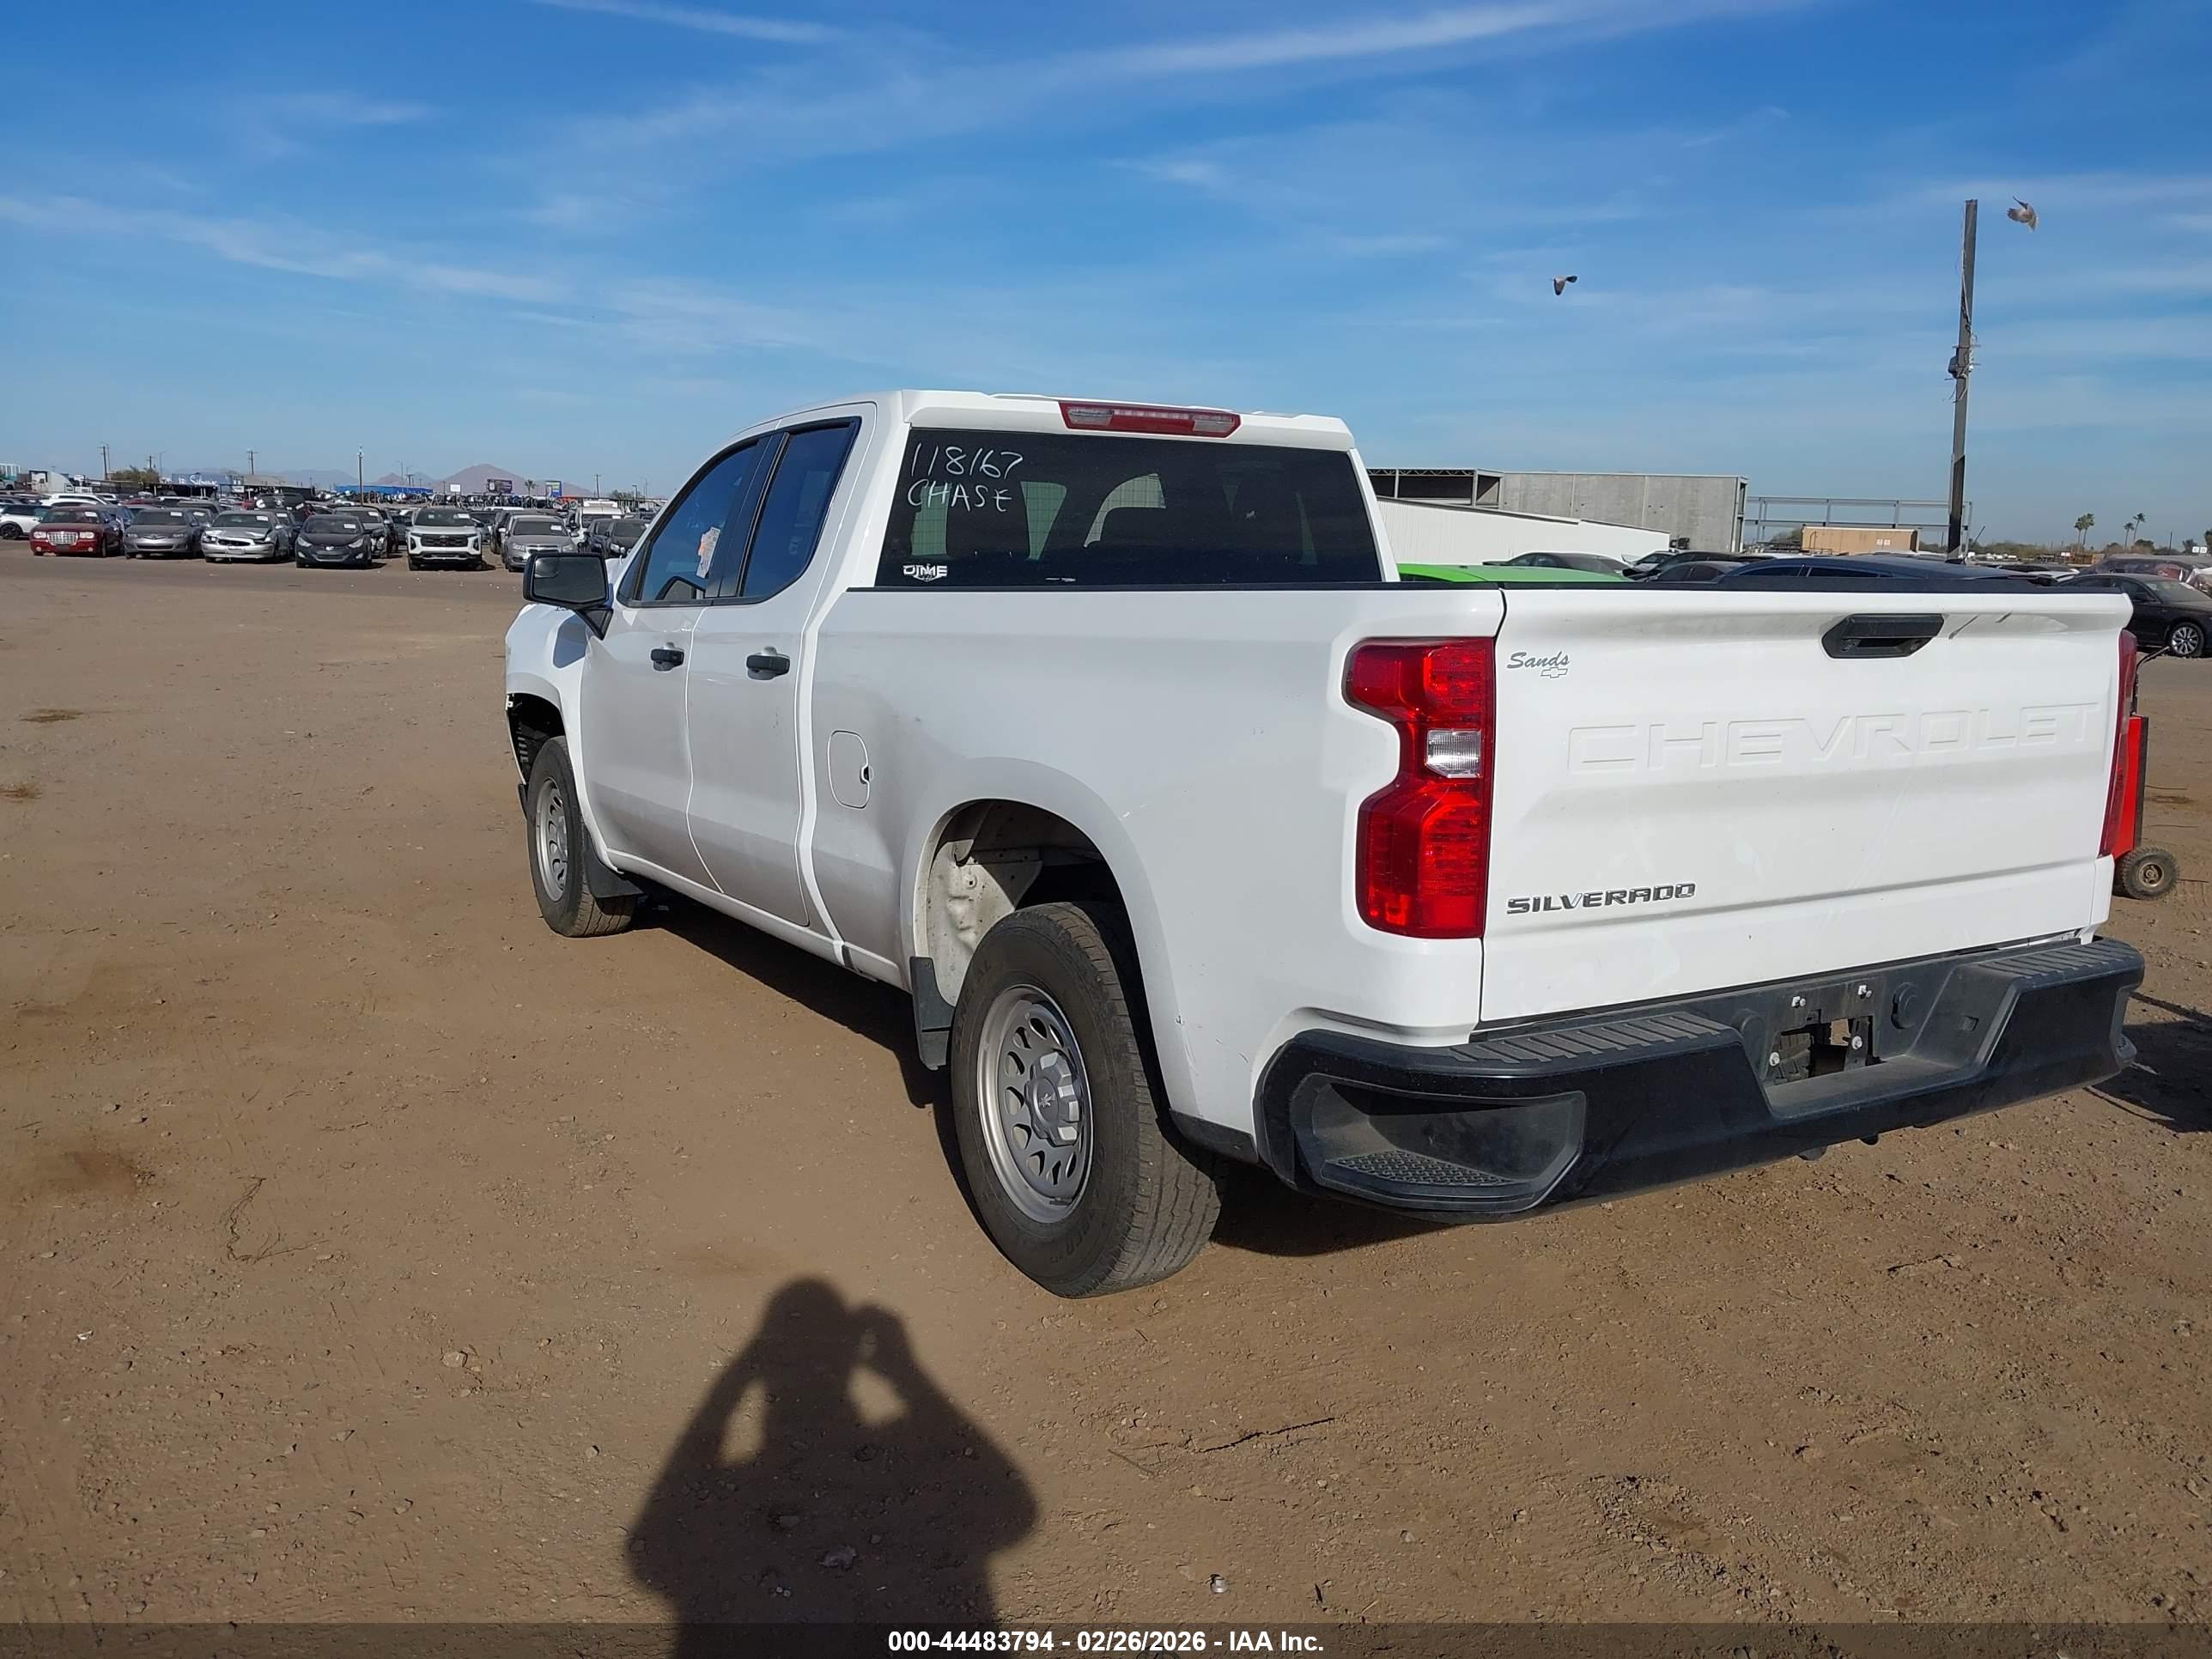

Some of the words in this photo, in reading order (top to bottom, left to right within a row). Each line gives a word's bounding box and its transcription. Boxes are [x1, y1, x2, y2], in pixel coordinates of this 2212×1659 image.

[911, 442, 1024, 479] 118167
[907, 478, 1012, 512] CHASE
[1506, 651, 1570, 669] Sands
[1567, 702, 2100, 775] CHEVROLET
[1506, 882, 1696, 915] SILVERADO
